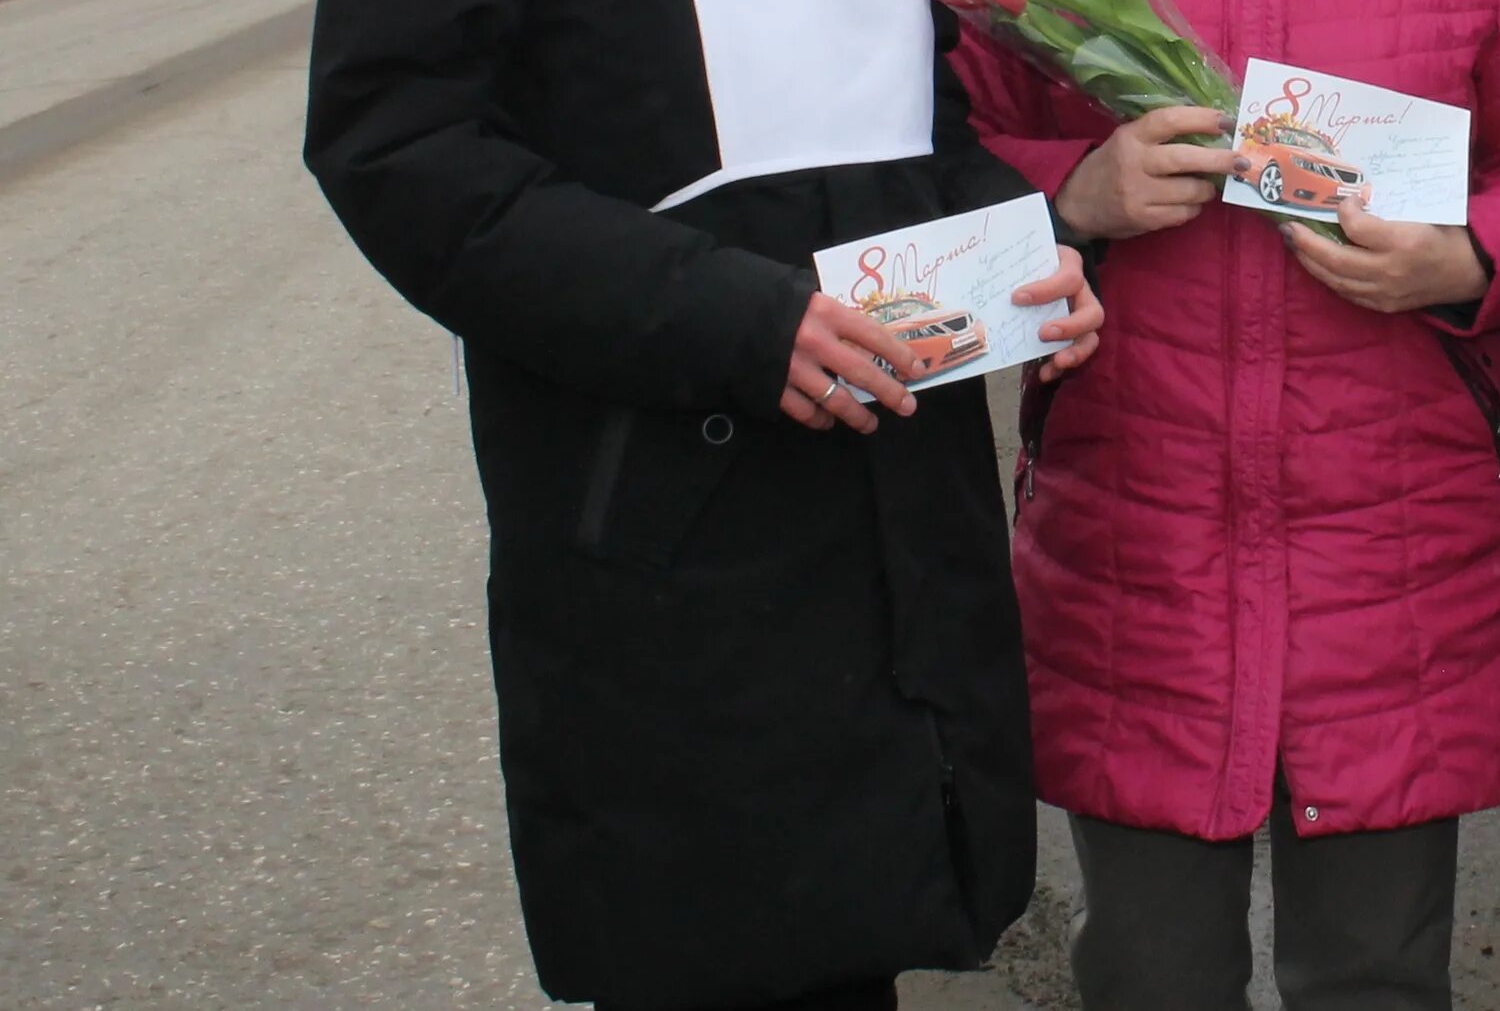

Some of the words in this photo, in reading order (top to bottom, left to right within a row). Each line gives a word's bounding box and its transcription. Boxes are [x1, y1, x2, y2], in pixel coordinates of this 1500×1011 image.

[1265, 77, 1312, 118] 8
[1301, 91, 1412, 146] Марта!
[851, 246, 886, 305] 8
[891, 212, 990, 301] Марта!
